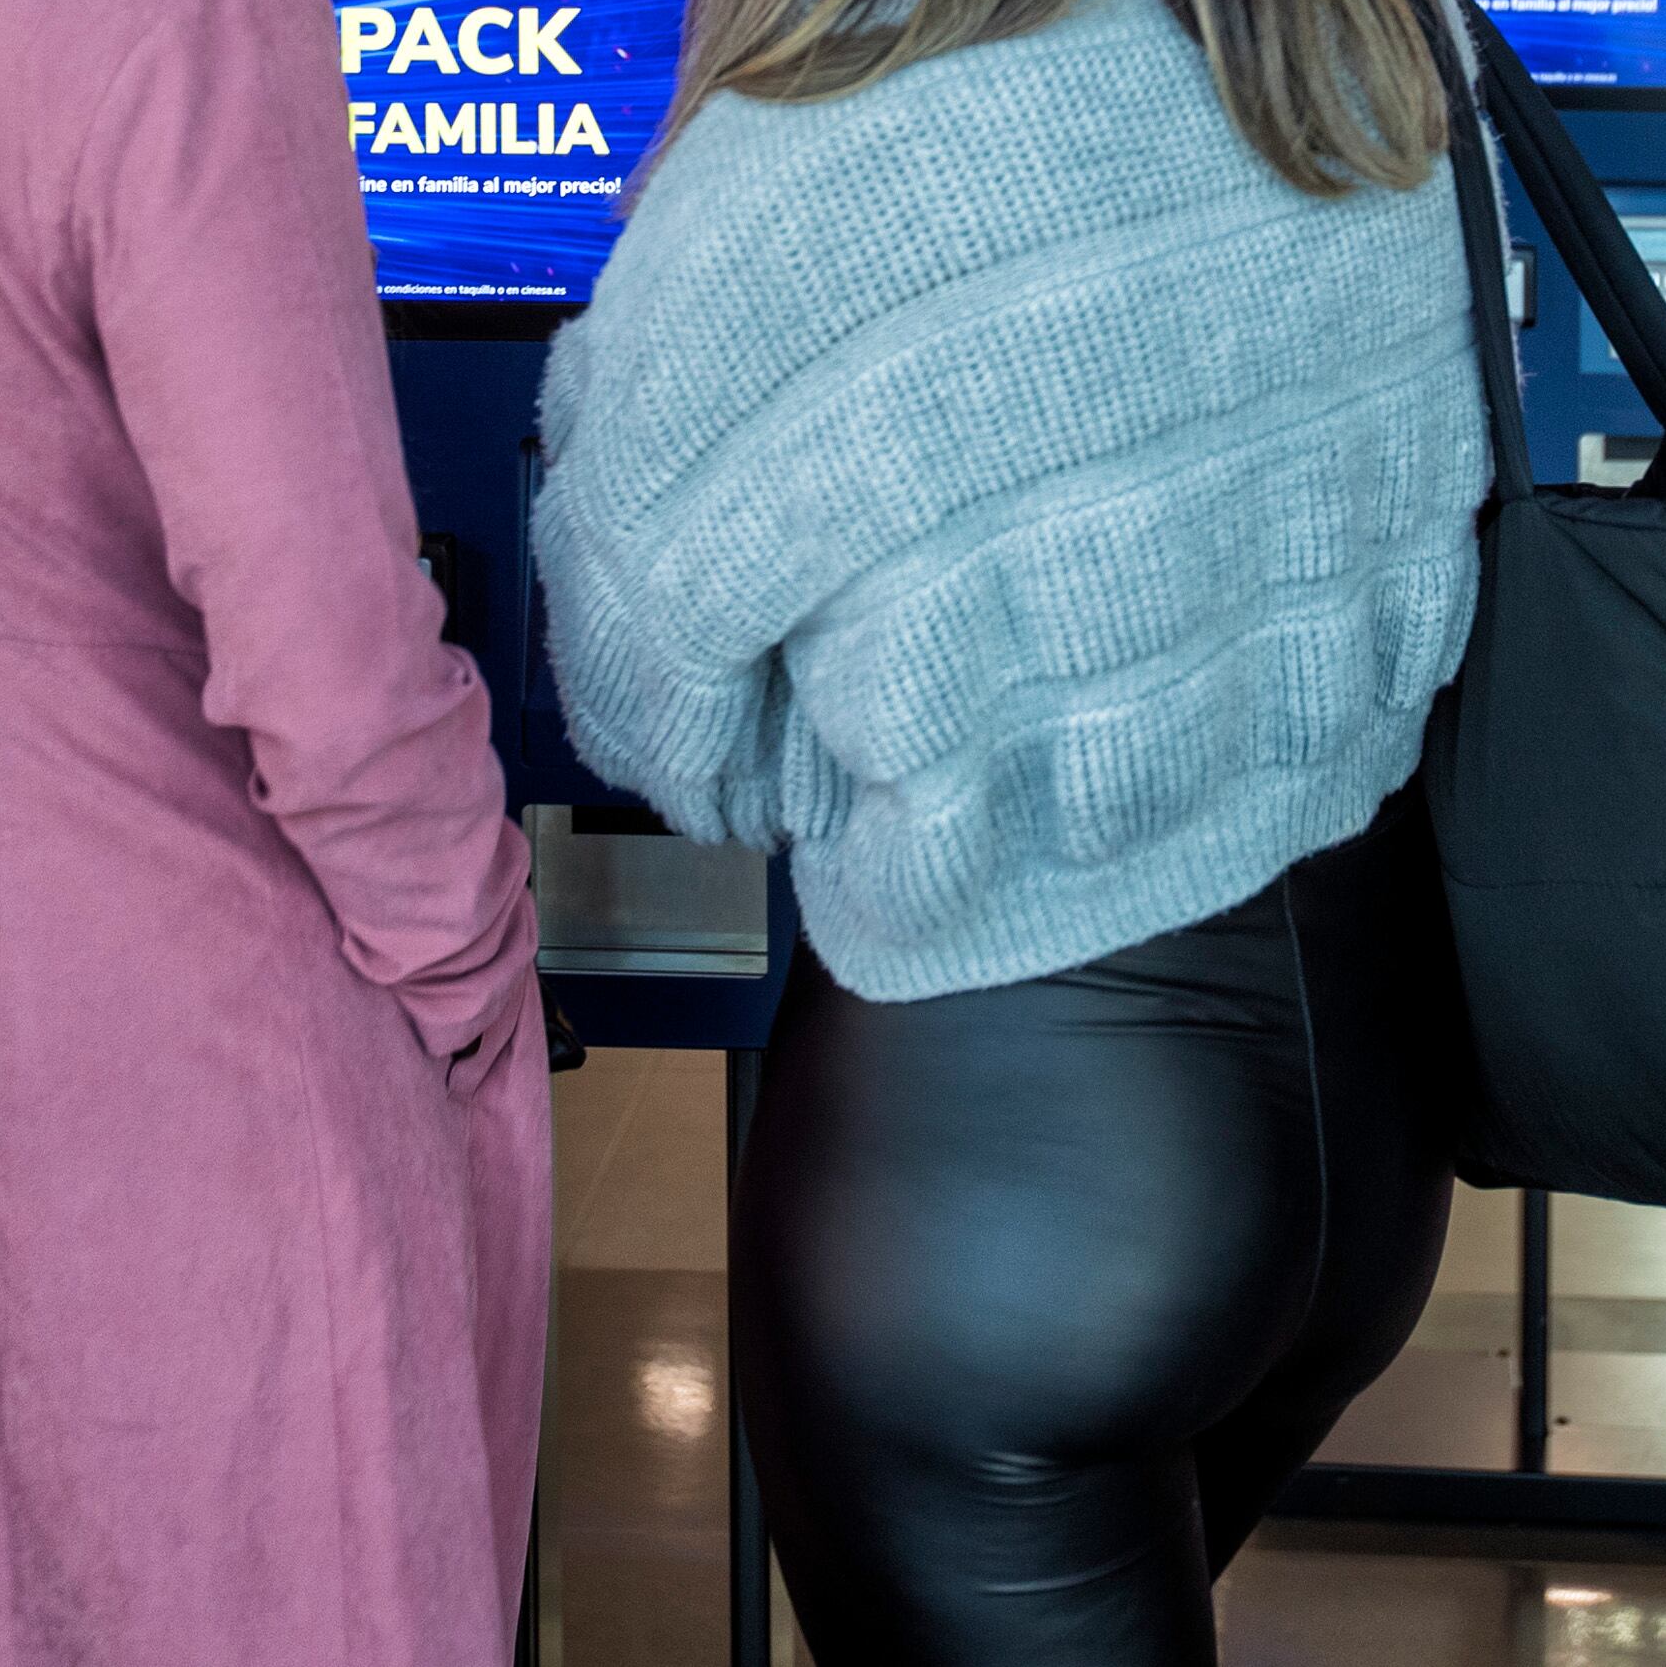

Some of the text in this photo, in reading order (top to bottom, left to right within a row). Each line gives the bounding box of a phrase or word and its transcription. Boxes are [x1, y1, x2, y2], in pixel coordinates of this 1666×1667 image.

[341, 6, 583, 75] PACK
[348, 102, 610, 155] FAMILIA
[391, 176, 621, 197] en familia al mejor precio!
[384, 284, 443, 295] condiciones
[444, 285, 457, 295] en
[459, 284, 496, 297] taquilla
[497, 286, 504, 295] o
[506, 286, 519, 295] en
[521, 285, 566, 296] cinesa.es
